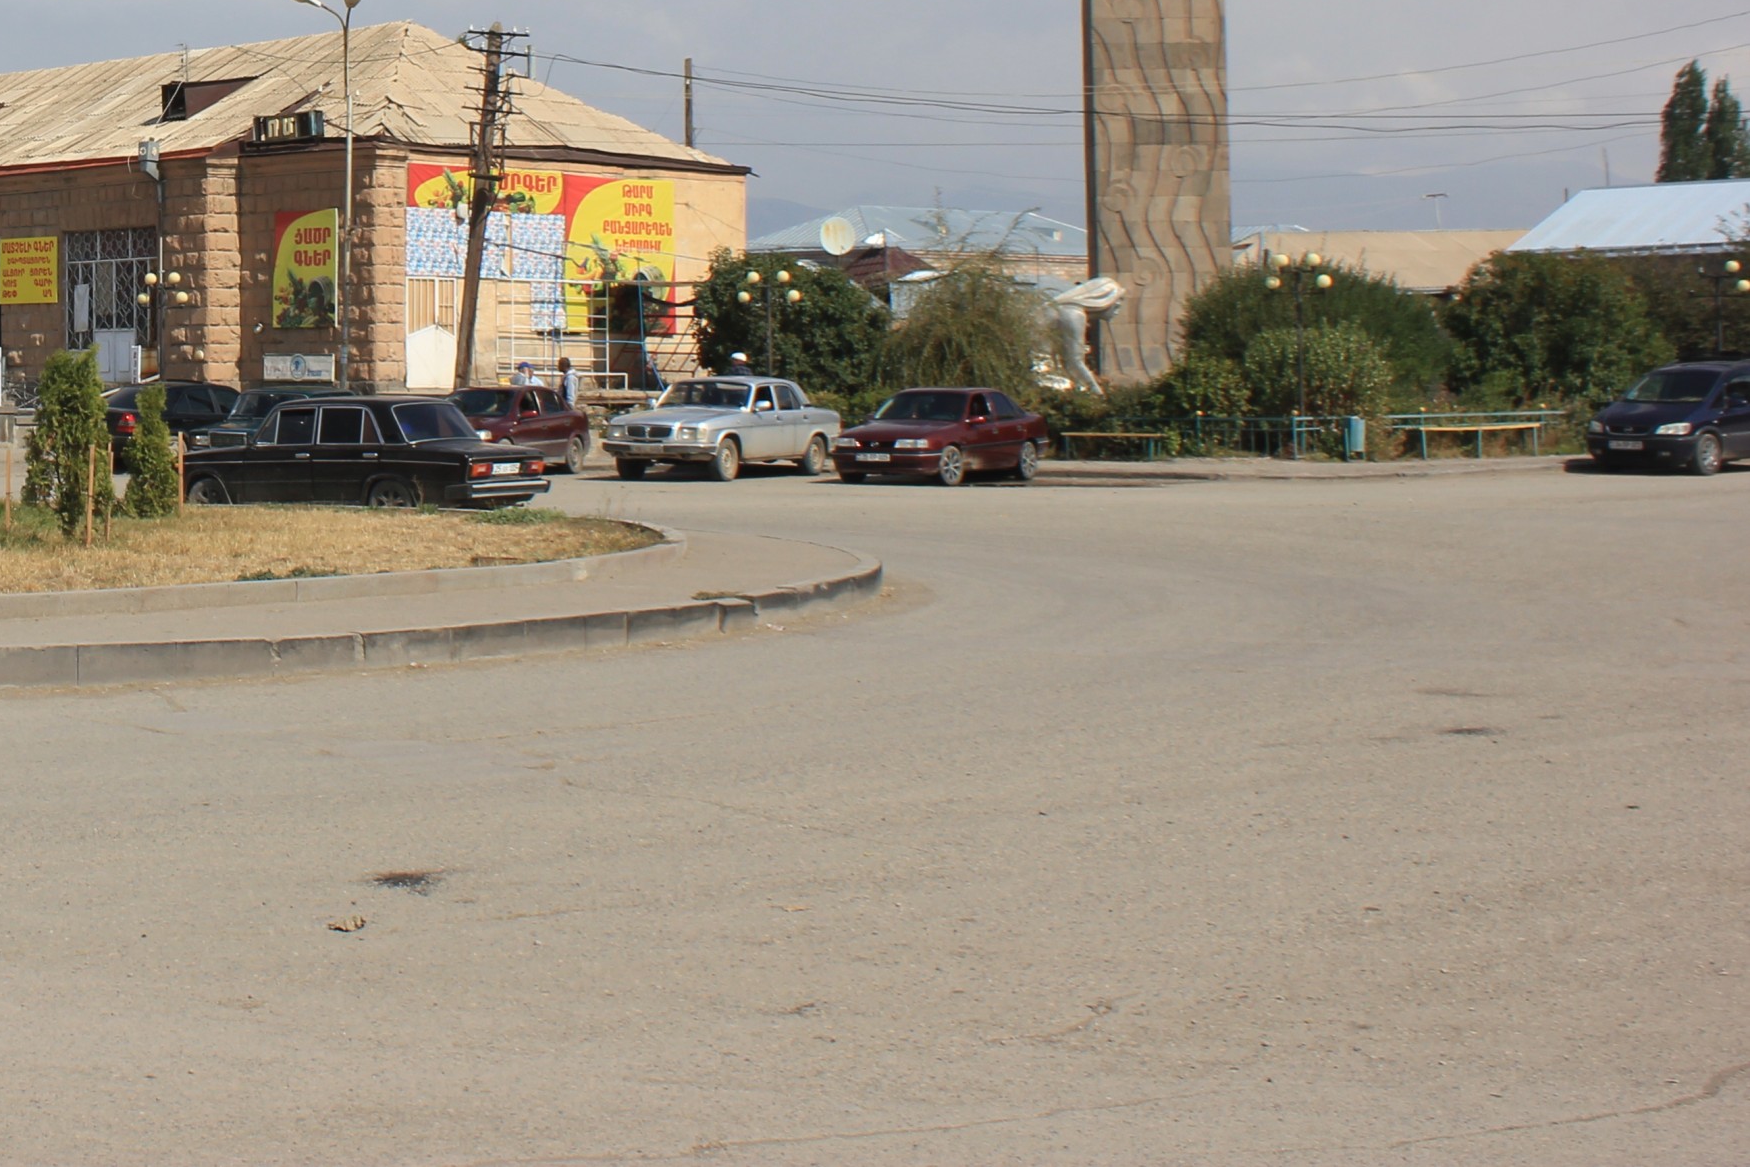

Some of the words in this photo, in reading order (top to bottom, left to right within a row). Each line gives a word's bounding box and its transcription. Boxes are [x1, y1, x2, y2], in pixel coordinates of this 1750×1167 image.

[498, 173, 557, 193] ՄՐԳԵՐ
[622, 184, 654, 199] ԹԱՐՄ
[624, 202, 653, 217] ՄԻՐԳ
[294, 227, 331, 245] ՑԱԾՐ
[603, 220, 673, 236] ԲԱՆՋԱՐԵՂԵՆ
[33, 240, 54, 252] ԳՆԵՐ
[294, 249, 331, 266] ԳՆԵՐ
